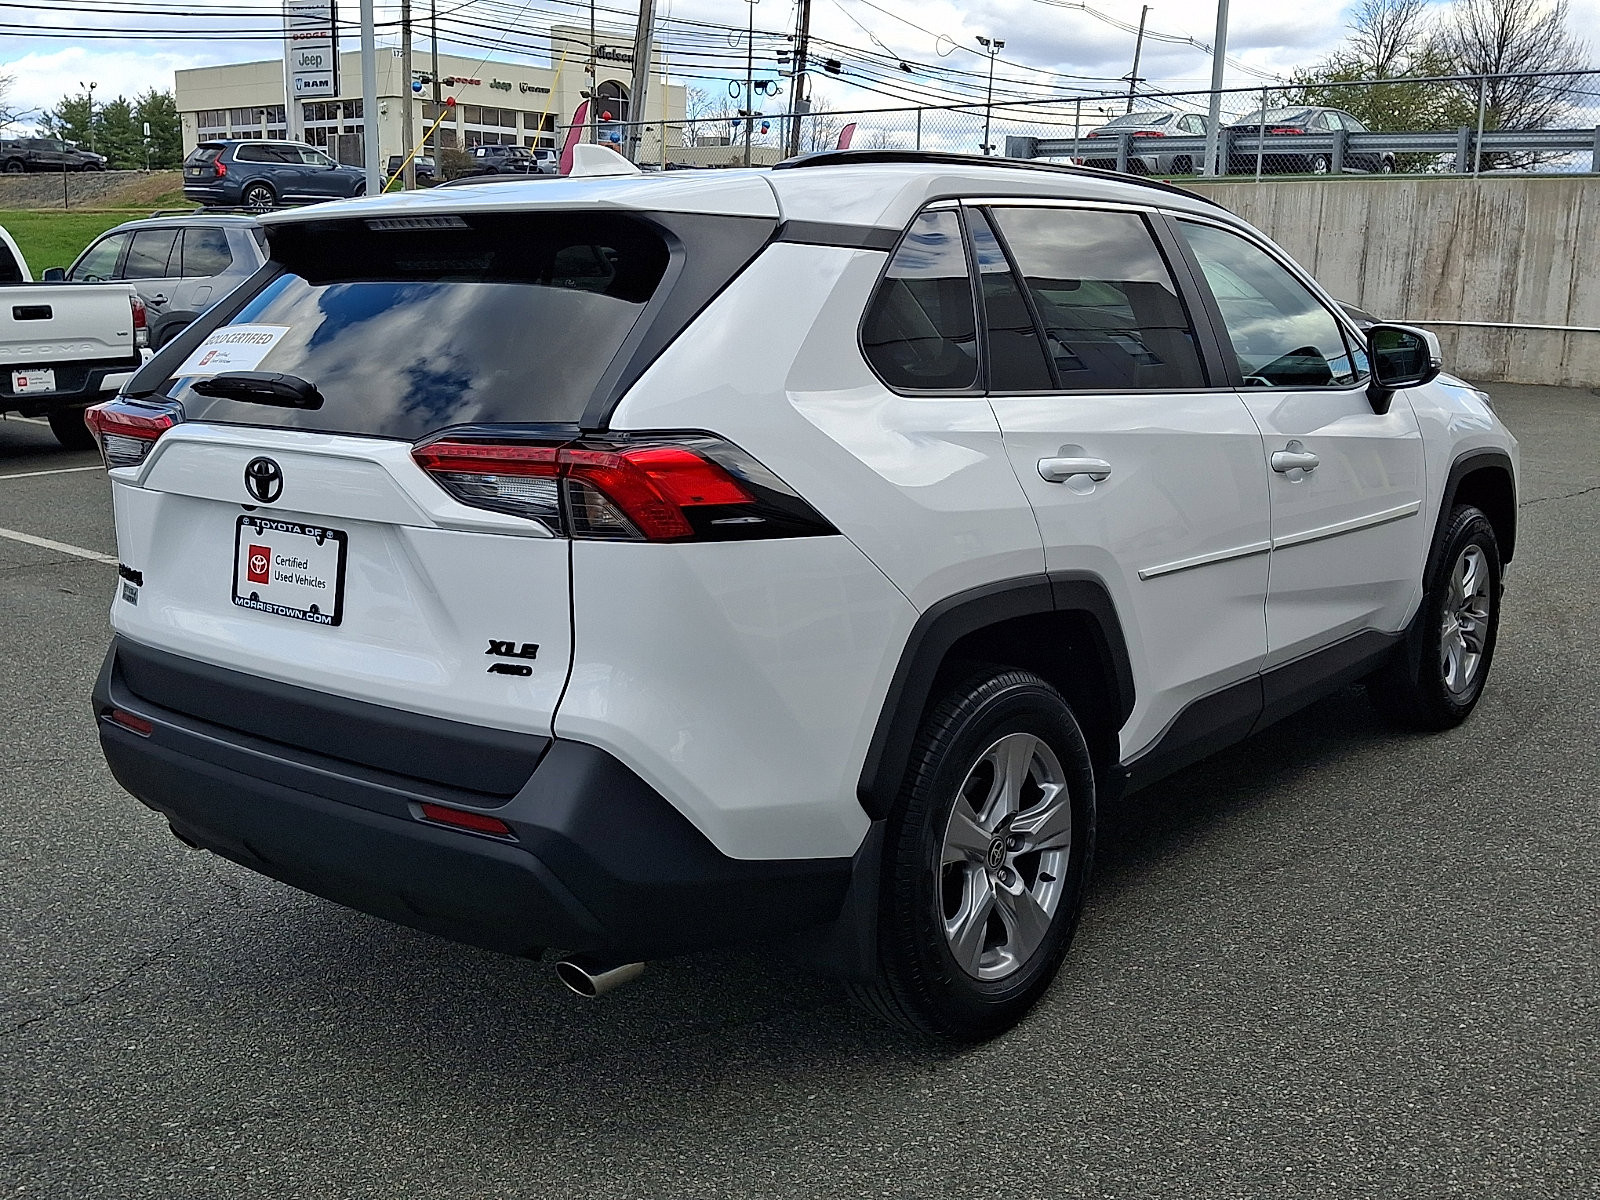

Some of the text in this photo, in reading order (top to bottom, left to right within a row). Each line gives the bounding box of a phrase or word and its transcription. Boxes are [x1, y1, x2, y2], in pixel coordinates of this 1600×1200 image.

[298, 52, 323, 68] Jeep
[303, 80, 329, 88] RAM
[225, 332, 274, 345] CERTIFIED
[254, 519, 322, 537] TOYOTA OF
[275, 554, 308, 570] Certified
[274, 570, 326, 589] Used Vehicles
[235, 597, 332, 625] MORRISTOWN.COM
[484, 639, 540, 660] XLE
